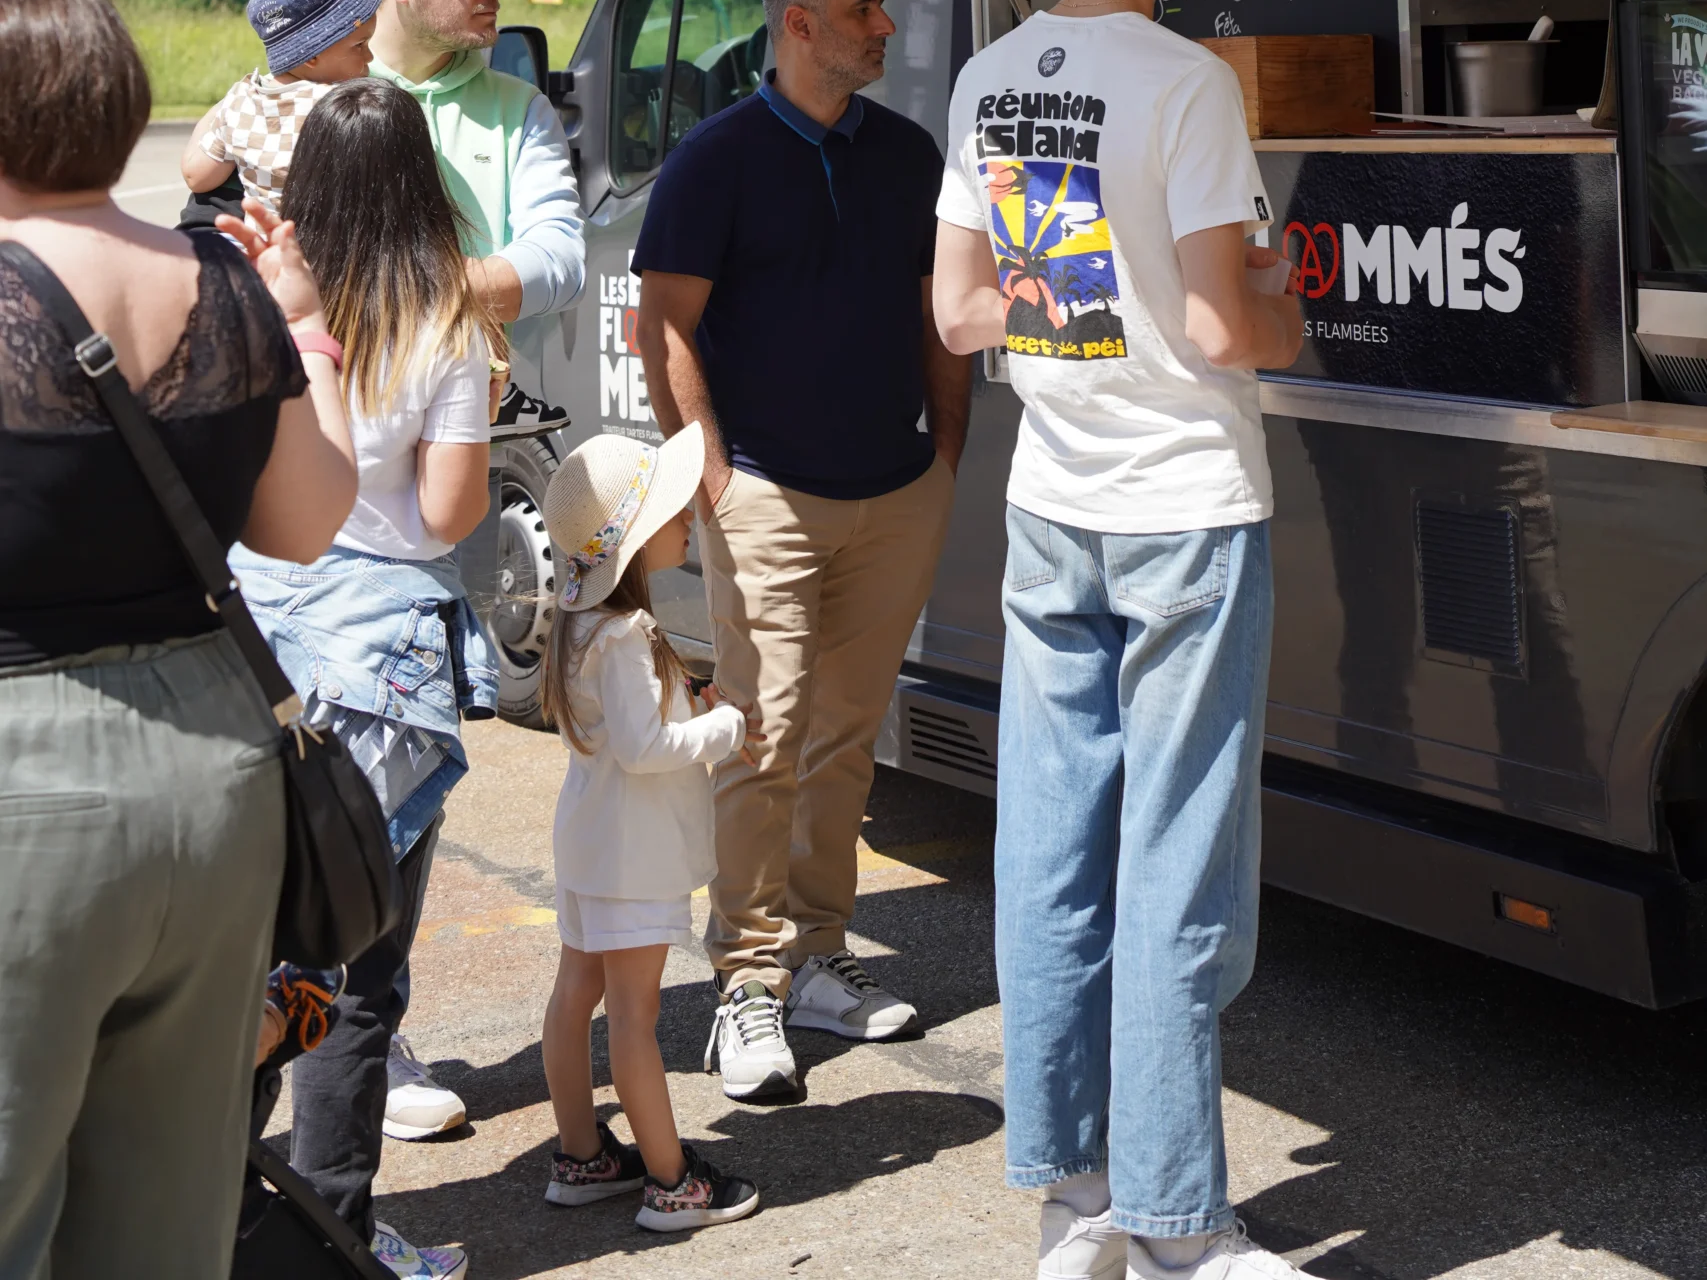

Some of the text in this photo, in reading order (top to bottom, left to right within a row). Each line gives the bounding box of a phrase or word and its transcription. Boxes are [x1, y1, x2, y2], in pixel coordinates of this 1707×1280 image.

[1671, 32, 1693, 66] LA
[1672, 68, 1703, 84] VEG
[976, 89, 1107, 126] Réunion
[976, 120, 1101, 163] island
[1255, 202, 1526, 313] AMMÉS
[600, 273, 628, 306] LES
[1007, 335, 1126, 359] ffet péi
[1317, 320, 1389, 344] FLAMBÉES
[600, 354, 657, 422] ME
